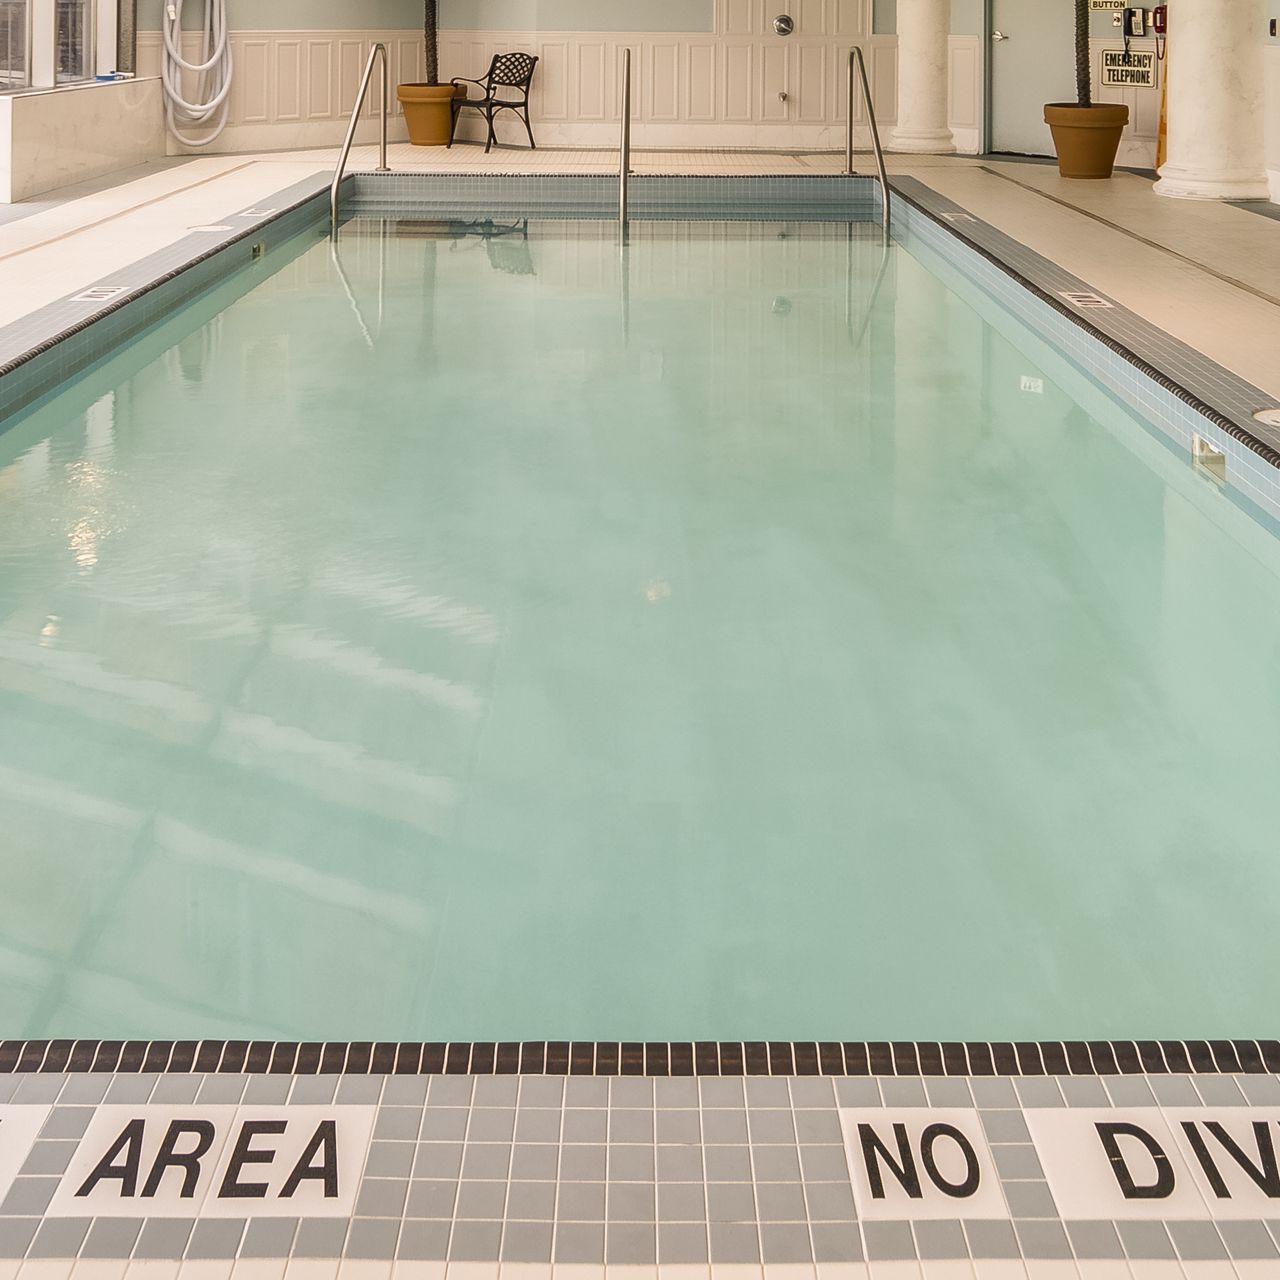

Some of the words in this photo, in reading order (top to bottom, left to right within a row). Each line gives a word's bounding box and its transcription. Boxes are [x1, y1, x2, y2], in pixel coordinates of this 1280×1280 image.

[1092, 0, 1125, 8] BUTTON
[1107, 69, 1150, 83] TELEPHONE
[75, 1119, 341, 1198] AREA
[857, 1122, 981, 1200] NO
